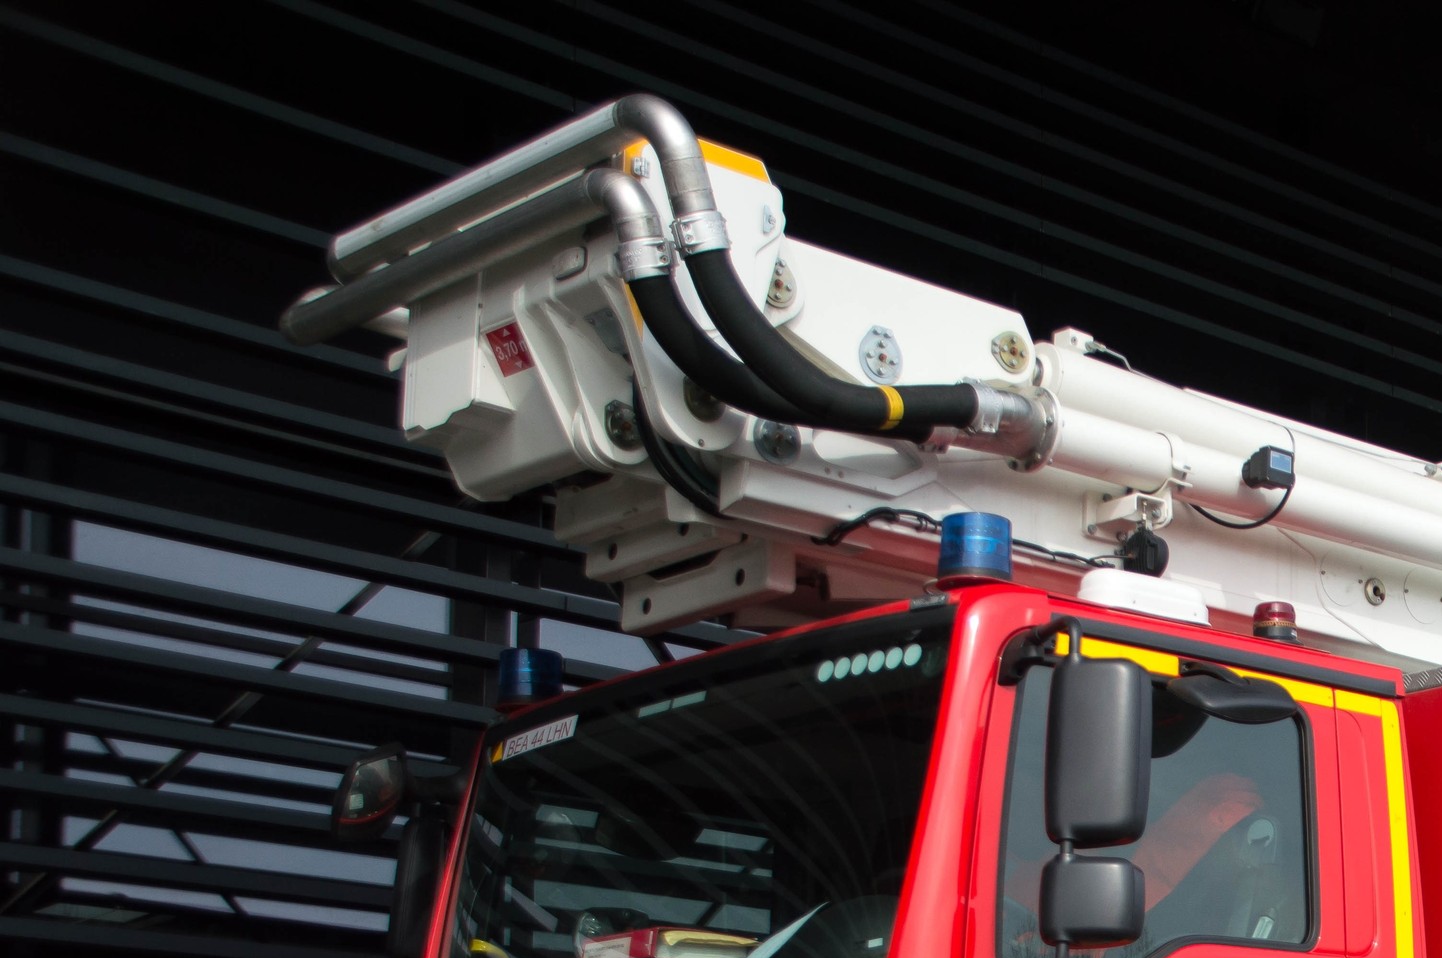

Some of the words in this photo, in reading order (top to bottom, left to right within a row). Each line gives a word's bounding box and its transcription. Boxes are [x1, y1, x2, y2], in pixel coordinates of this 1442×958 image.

[495, 340, 519, 361] 3,70
[507, 735, 529, 758] BEA
[531, 729, 545, 748] 44
[546, 720, 573, 744] LHN
